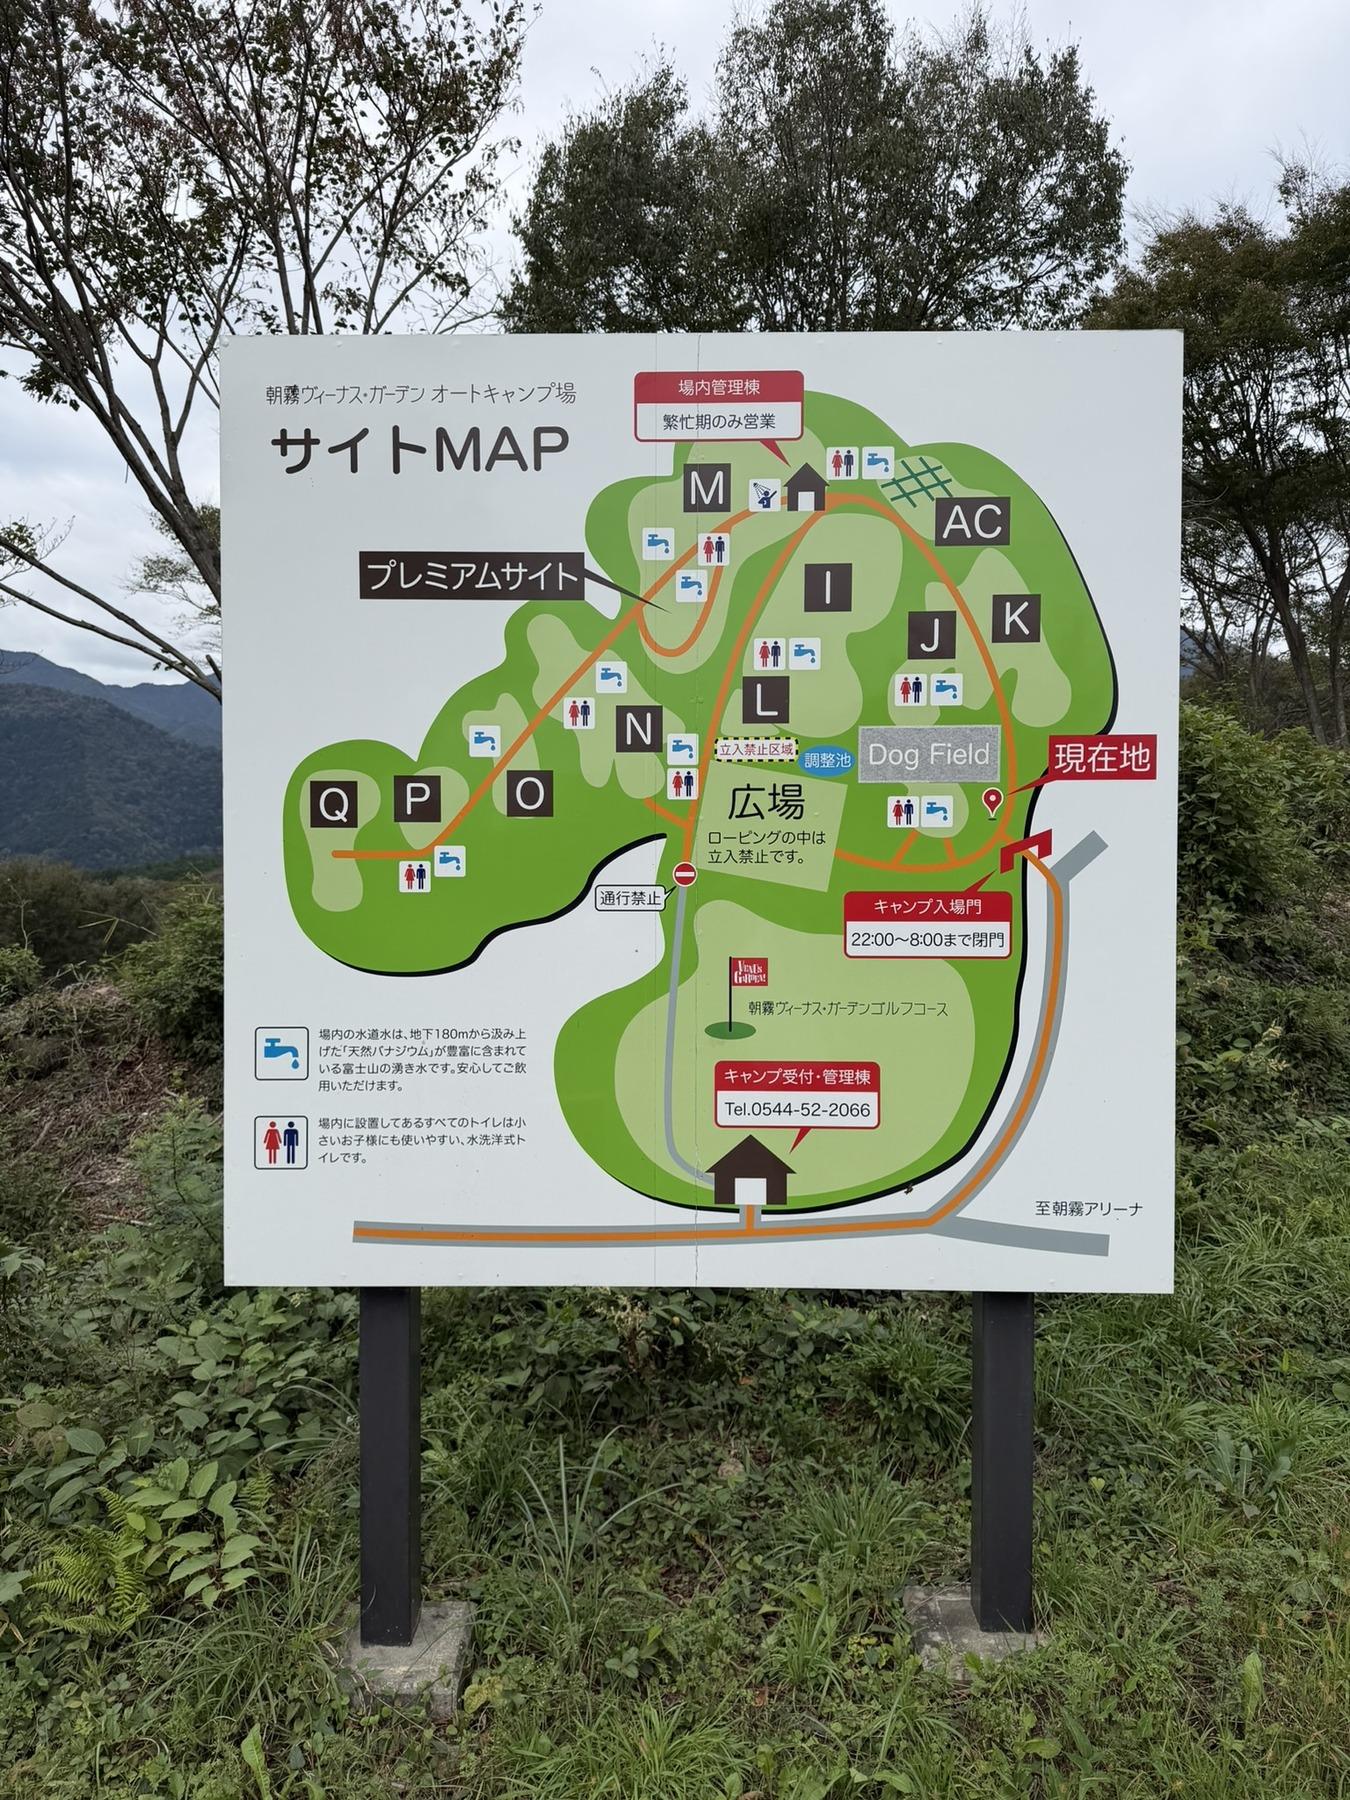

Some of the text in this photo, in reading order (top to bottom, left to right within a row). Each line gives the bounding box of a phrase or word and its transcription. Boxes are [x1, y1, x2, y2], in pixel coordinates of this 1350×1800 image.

[431, 382, 577, 404] オートキャンプ場
[678, 379, 761, 396] 場内管理棟
[663, 413, 776, 431] 繁忙期のみ営業
[271, 425, 569, 474] サイトMAP
[690, 472, 724, 505] M
[942, 504, 1003, 540] AC
[366, 559, 578, 591] プレミアムサイト
[824, 570, 832, 605] I
[1004, 601, 1030, 636] K
[920, 617, 940, 653] J
[755, 683, 779, 717] L
[625, 712, 652, 746] N
[719, 743, 794, 757] 立入禁止区域
[868, 742, 990, 770] Dog Field
[1054, 743, 1151, 774] 現在地
[804, 752, 851, 769] 調整池
[406, 782, 431, 815] P
[515, 775, 546, 811] O
[728, 783, 806, 820] 広場
[319, 787, 348, 823] Q
[708, 830, 826, 846] ローピングの中は
[708, 849, 804, 865] 立入禁止です。
[600, 890, 662, 907] 通行禁止
[874, 899, 983, 916] キャンプ入場門
[319, 1028, 527, 1041] 場内の水道水は、地下180mから汲み上
[319, 1062, 527, 1075] いる富士山の湧き水です。安心してご飲
[723, 1068, 871, 1086] キャンプ受付・管理棟
[318, 1080, 403, 1092] 用いただけます。
[724, 1101, 871, 1118] Tel.0544-52-2066
[318, 1117, 527, 1130] 場内に設置してあるすべてのトイレは小
[318, 1134, 527, 1147] さいお子様にも使いやすい、水洗洋式ト
[318, 1151, 367, 1164] イレです。
[1035, 1201, 1144, 1218] 至朝霧アリーナ
